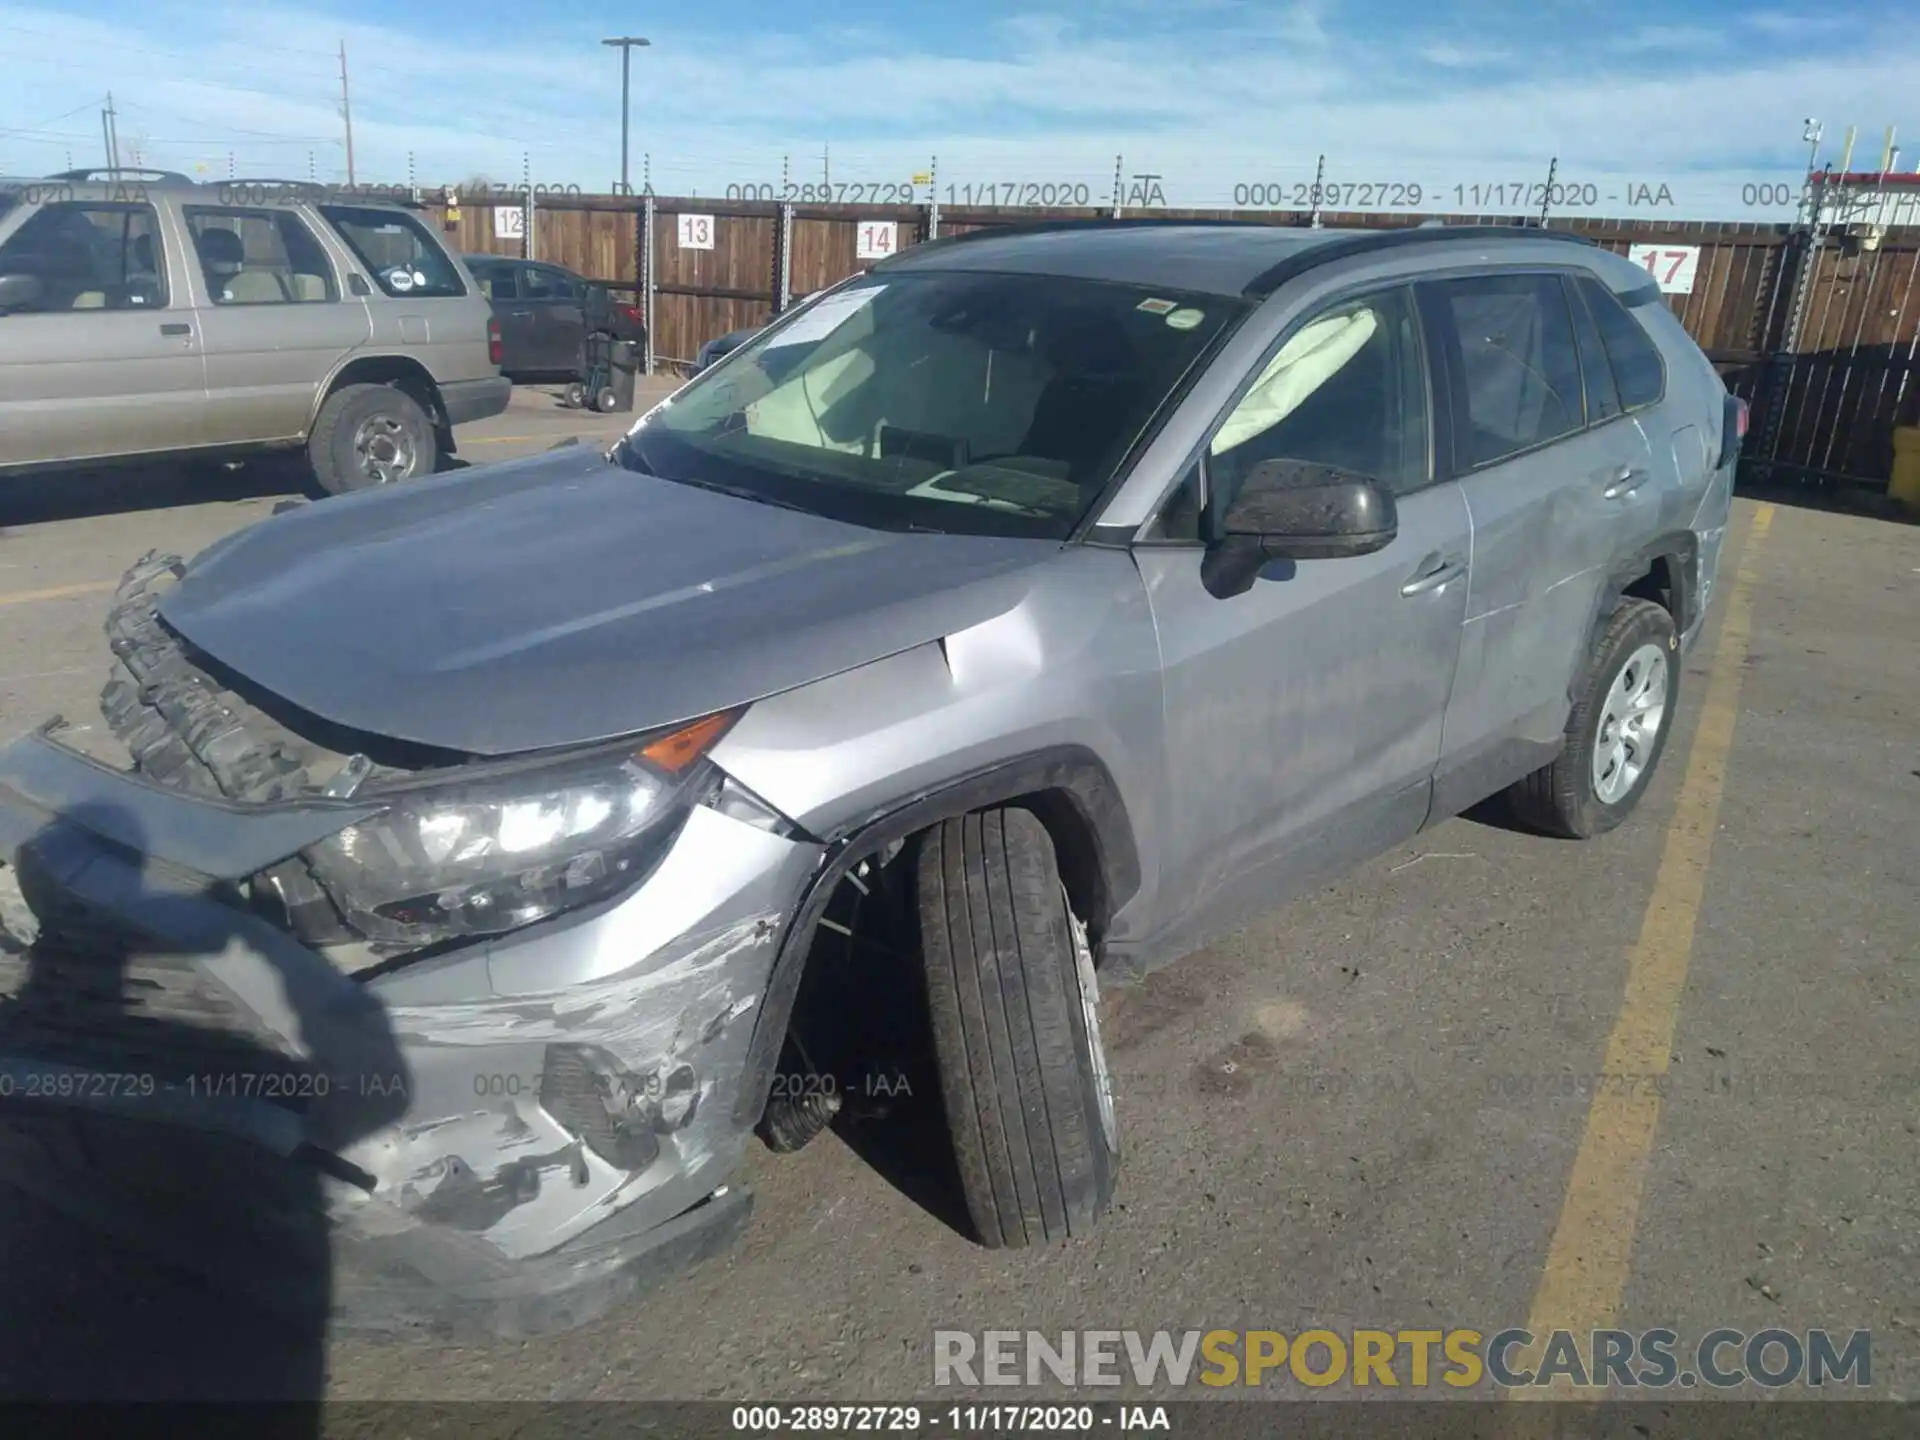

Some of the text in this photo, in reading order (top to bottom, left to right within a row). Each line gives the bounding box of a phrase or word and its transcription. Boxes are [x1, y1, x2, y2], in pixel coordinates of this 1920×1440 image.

[500, 210, 523, 233] 12
[685, 217, 708, 243] 13
[864, 226, 891, 252] 14
[1641, 250, 1688, 284] 17
